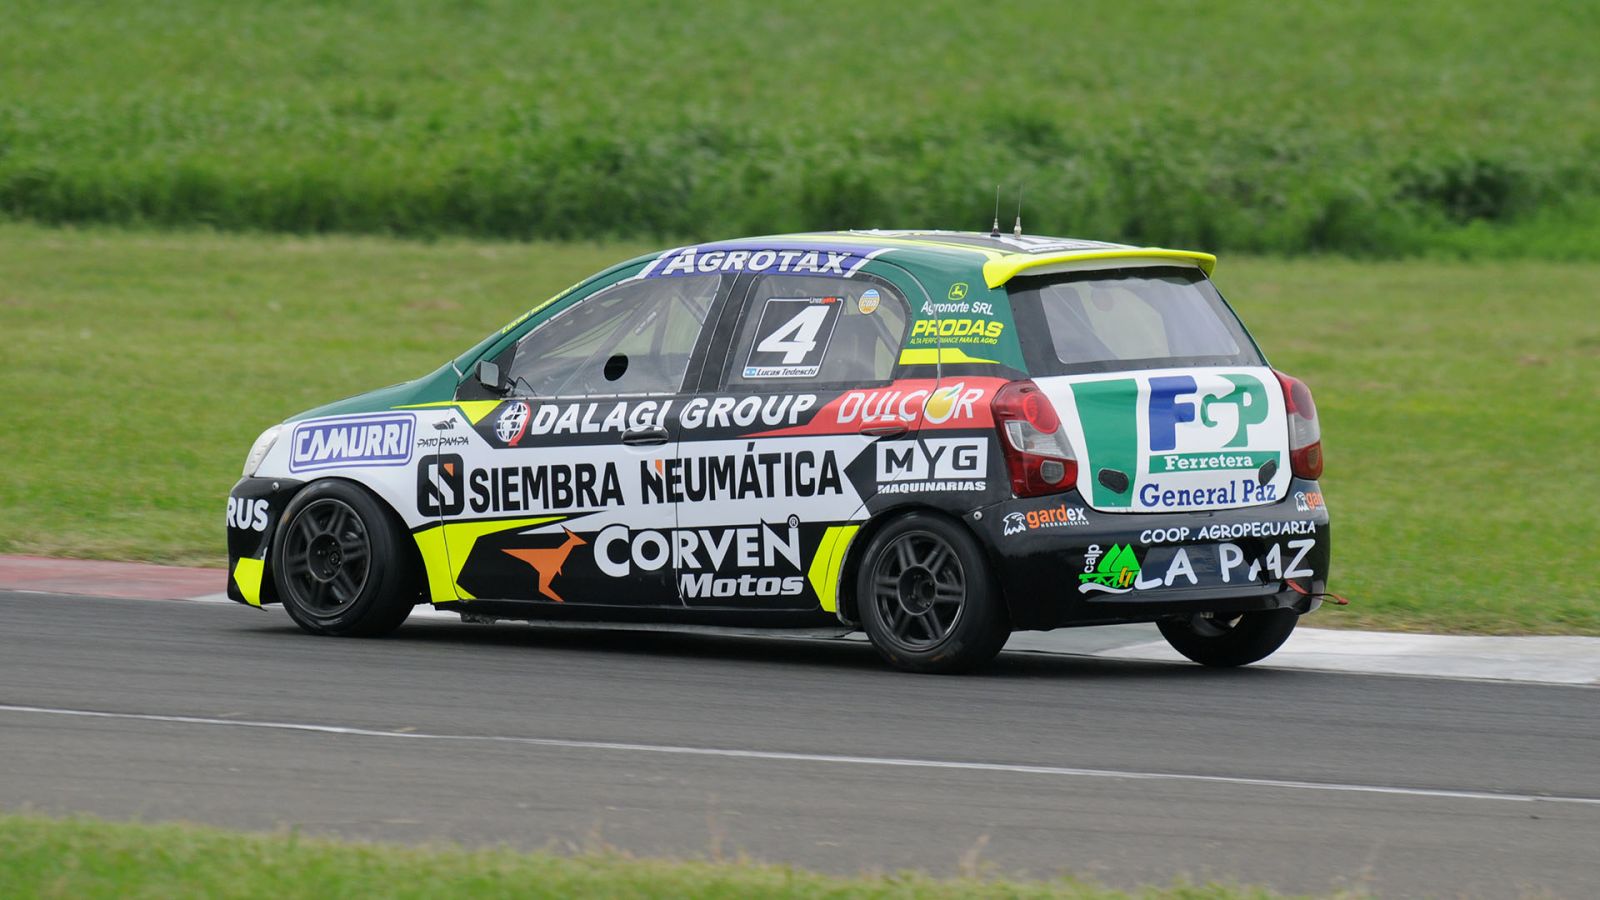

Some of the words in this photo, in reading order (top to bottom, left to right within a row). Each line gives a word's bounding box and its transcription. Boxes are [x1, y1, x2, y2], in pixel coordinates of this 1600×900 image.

[661, 248, 852, 275] AGROTAX
[921, 301, 969, 316] Agronorte
[971, 301, 994, 316] SRL
[757, 305, 830, 364] 4
[911, 319, 1004, 338] PRODAS
[756, 368, 780, 376] Lucas
[782, 367, 818, 376] Tedeschi
[531, 400, 673, 436] DALAGI
[680, 394, 817, 430] GROUP
[837, 384, 984, 425] DULCOR
[1148, 374, 1268, 451] FGP
[294, 421, 409, 463] CAMURRI
[417, 438, 438, 448] PATO
[440, 436, 469, 446] PAMPA
[884, 439, 979, 479] MYG
[1163, 454, 1254, 470] Ferretera
[469, 461, 625, 513] SIEMBRA
[640, 442, 844, 505] NEUMÁTICA
[877, 481, 987, 494] MAQUINARIAS
[1139, 481, 1236, 507] General
[1242, 480, 1277, 502] Paz
[1026, 504, 1087, 528] gardex
[1041, 520, 1089, 528] HERRAMIENTAS
[594, 518, 801, 577] CORVEN
[1084, 544, 1103, 573] calp
[1134, 548, 1198, 590] LA
[1218, 539, 1316, 583] PAZ
[680, 573, 804, 598] Motos
